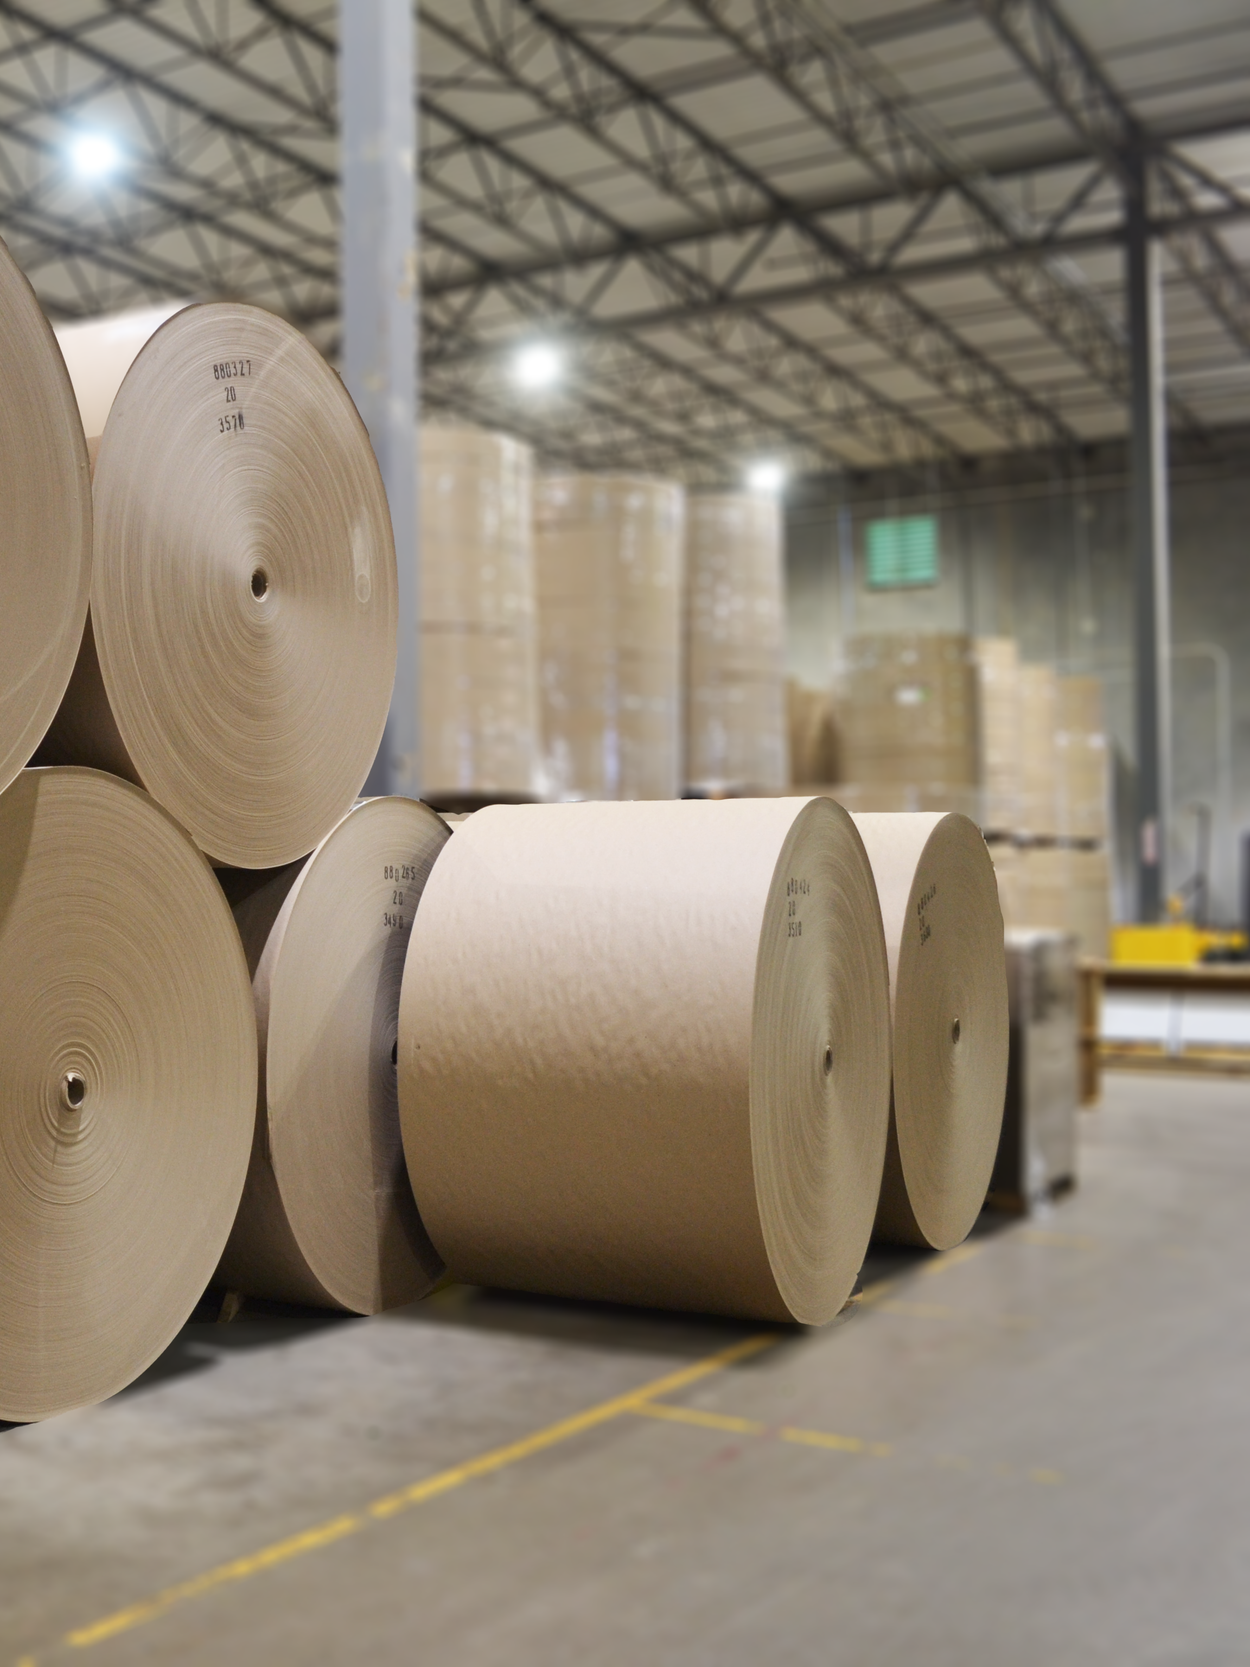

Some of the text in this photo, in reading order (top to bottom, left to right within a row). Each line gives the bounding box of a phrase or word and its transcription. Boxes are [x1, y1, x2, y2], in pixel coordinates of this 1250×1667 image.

[213, 359, 252, 380] 880327
[224, 385, 237, 403] 20
[392, 890, 404, 906] 20
